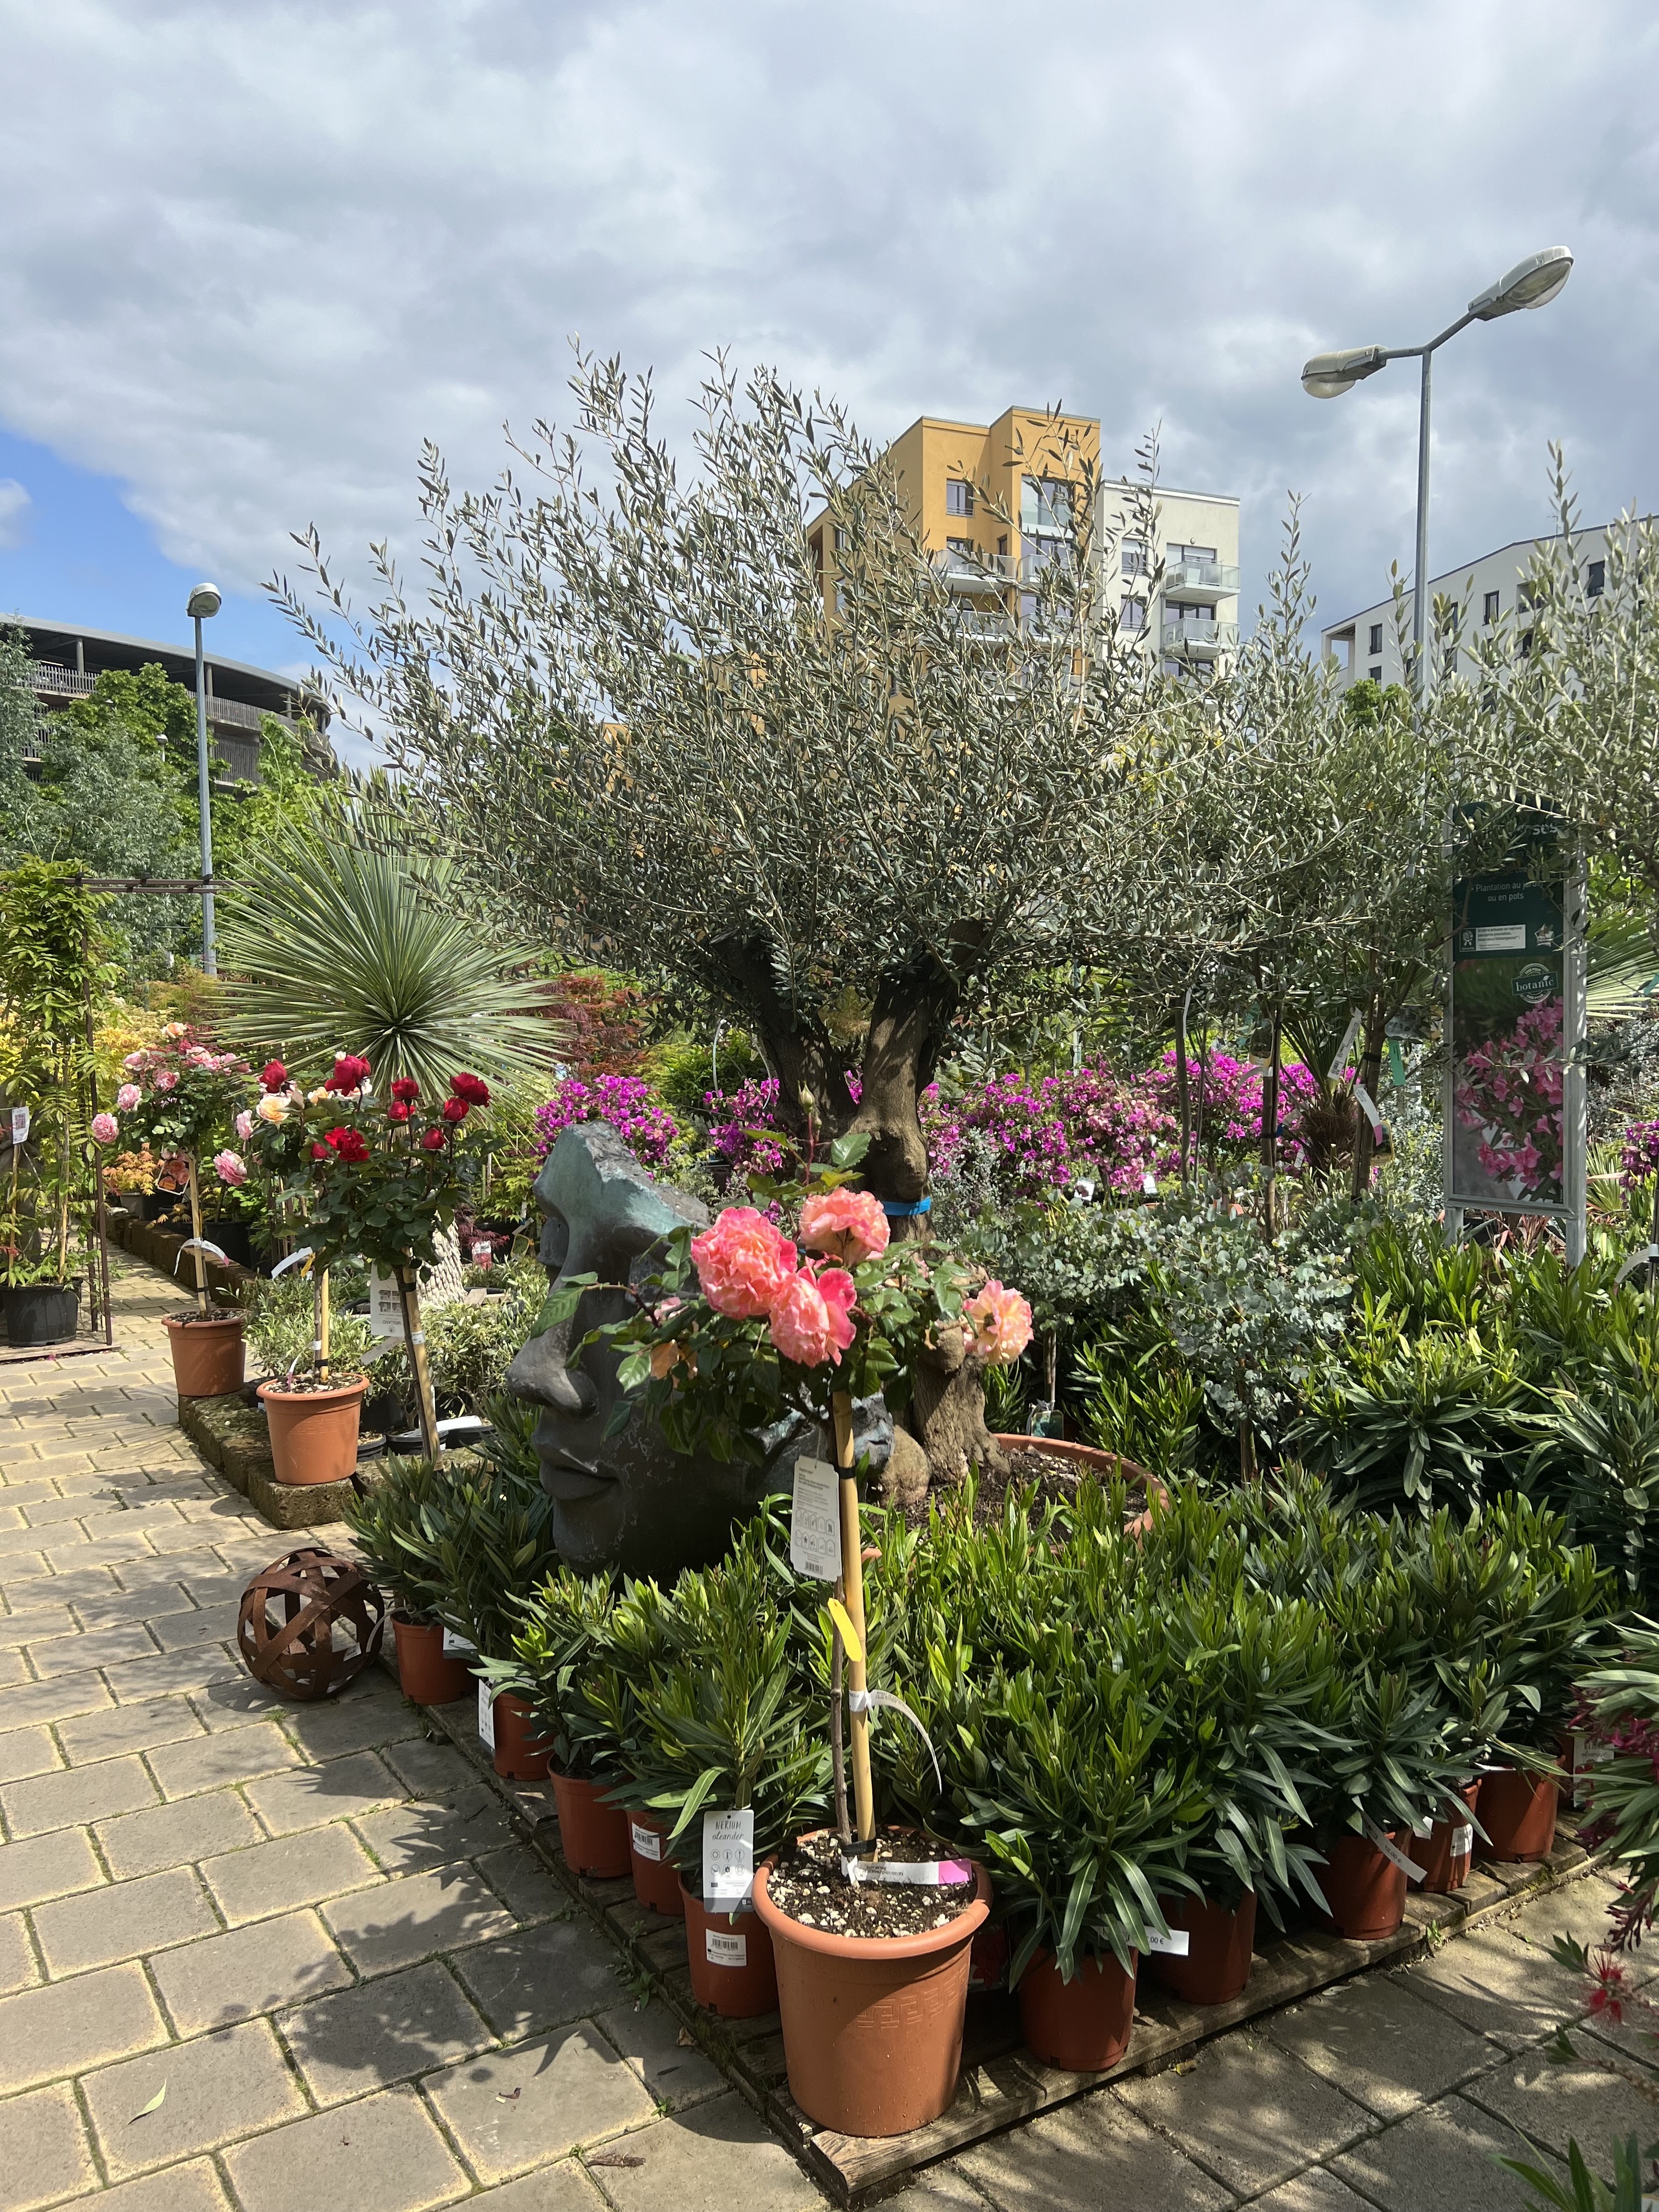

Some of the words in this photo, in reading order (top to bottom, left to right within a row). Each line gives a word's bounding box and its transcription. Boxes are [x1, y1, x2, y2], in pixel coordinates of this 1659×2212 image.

[1476, 883, 1510, 892] Plantation
[1509, 892, 1524, 902] pots
[1516, 978, 1554, 991] botanic
[715, 1821, 741, 1830] NERIUM
[712, 1831, 744, 1841] oleander
